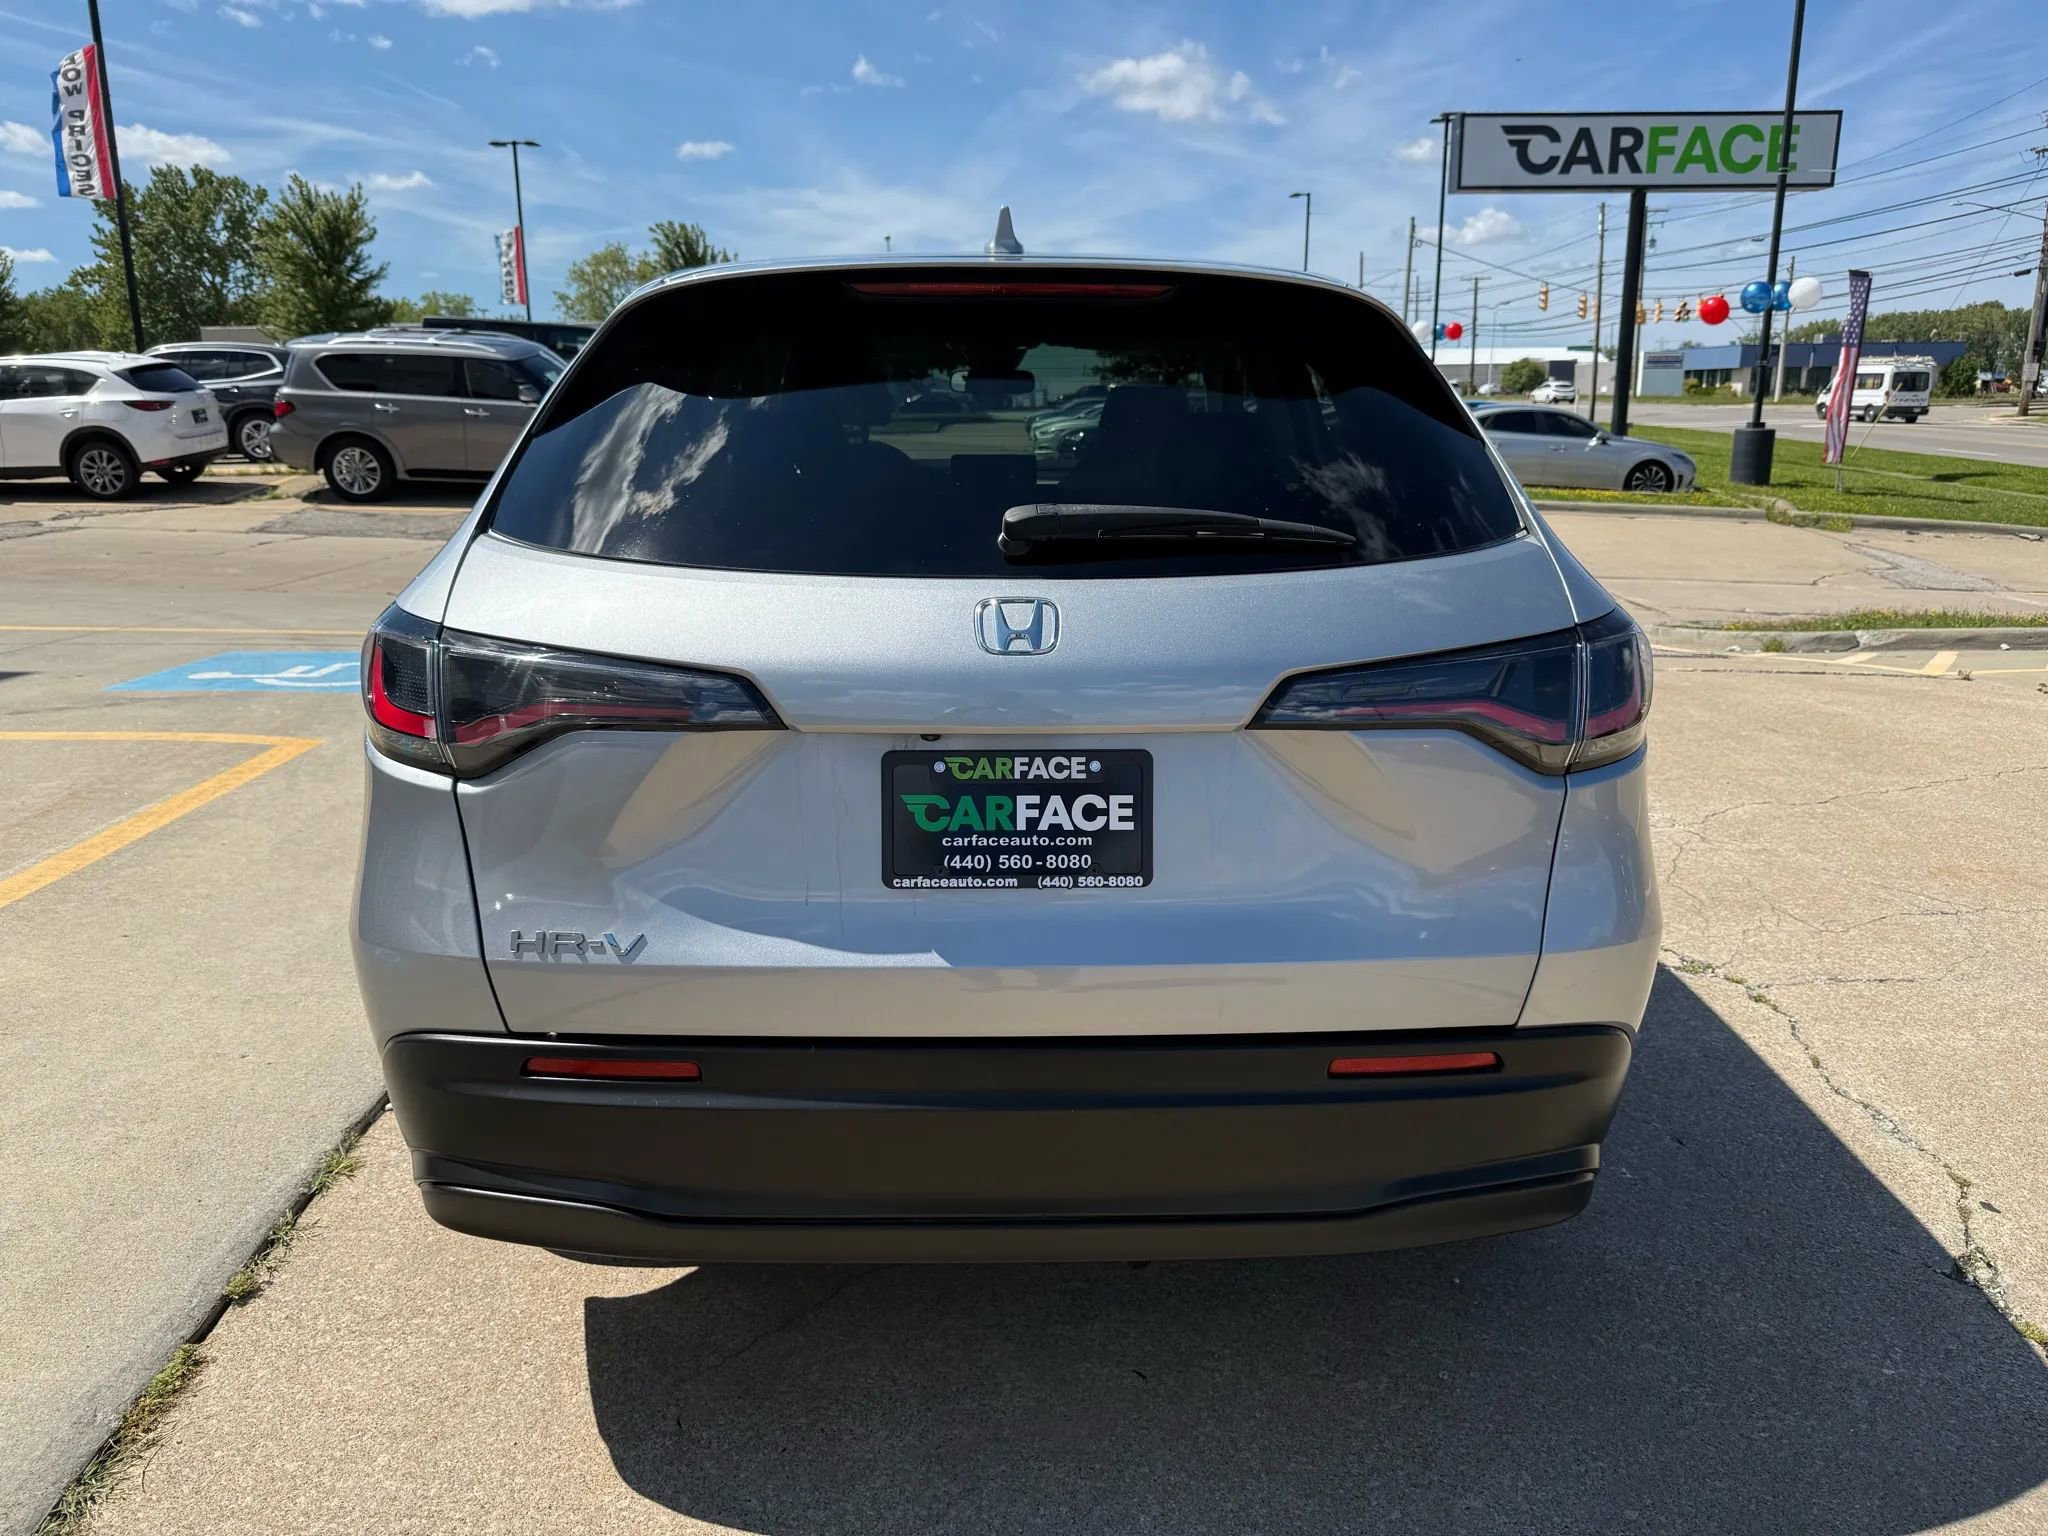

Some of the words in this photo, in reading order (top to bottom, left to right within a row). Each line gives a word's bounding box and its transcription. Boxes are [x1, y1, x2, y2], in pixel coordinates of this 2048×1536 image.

[1500, 124, 1801, 175] CARFACE
[944, 756, 1087, 779] CARFACE
[900, 794, 1135, 832] CARFACE
[942, 834, 1093, 846] carfaceauto.com
[943, 854, 992, 873] (440)
[893, 876, 1018, 888] carfaceauto.com
[1037, 876, 1074, 889] (440)
[1077, 876, 1144, 887] 560-8080
[510, 929, 648, 958] HR-V
